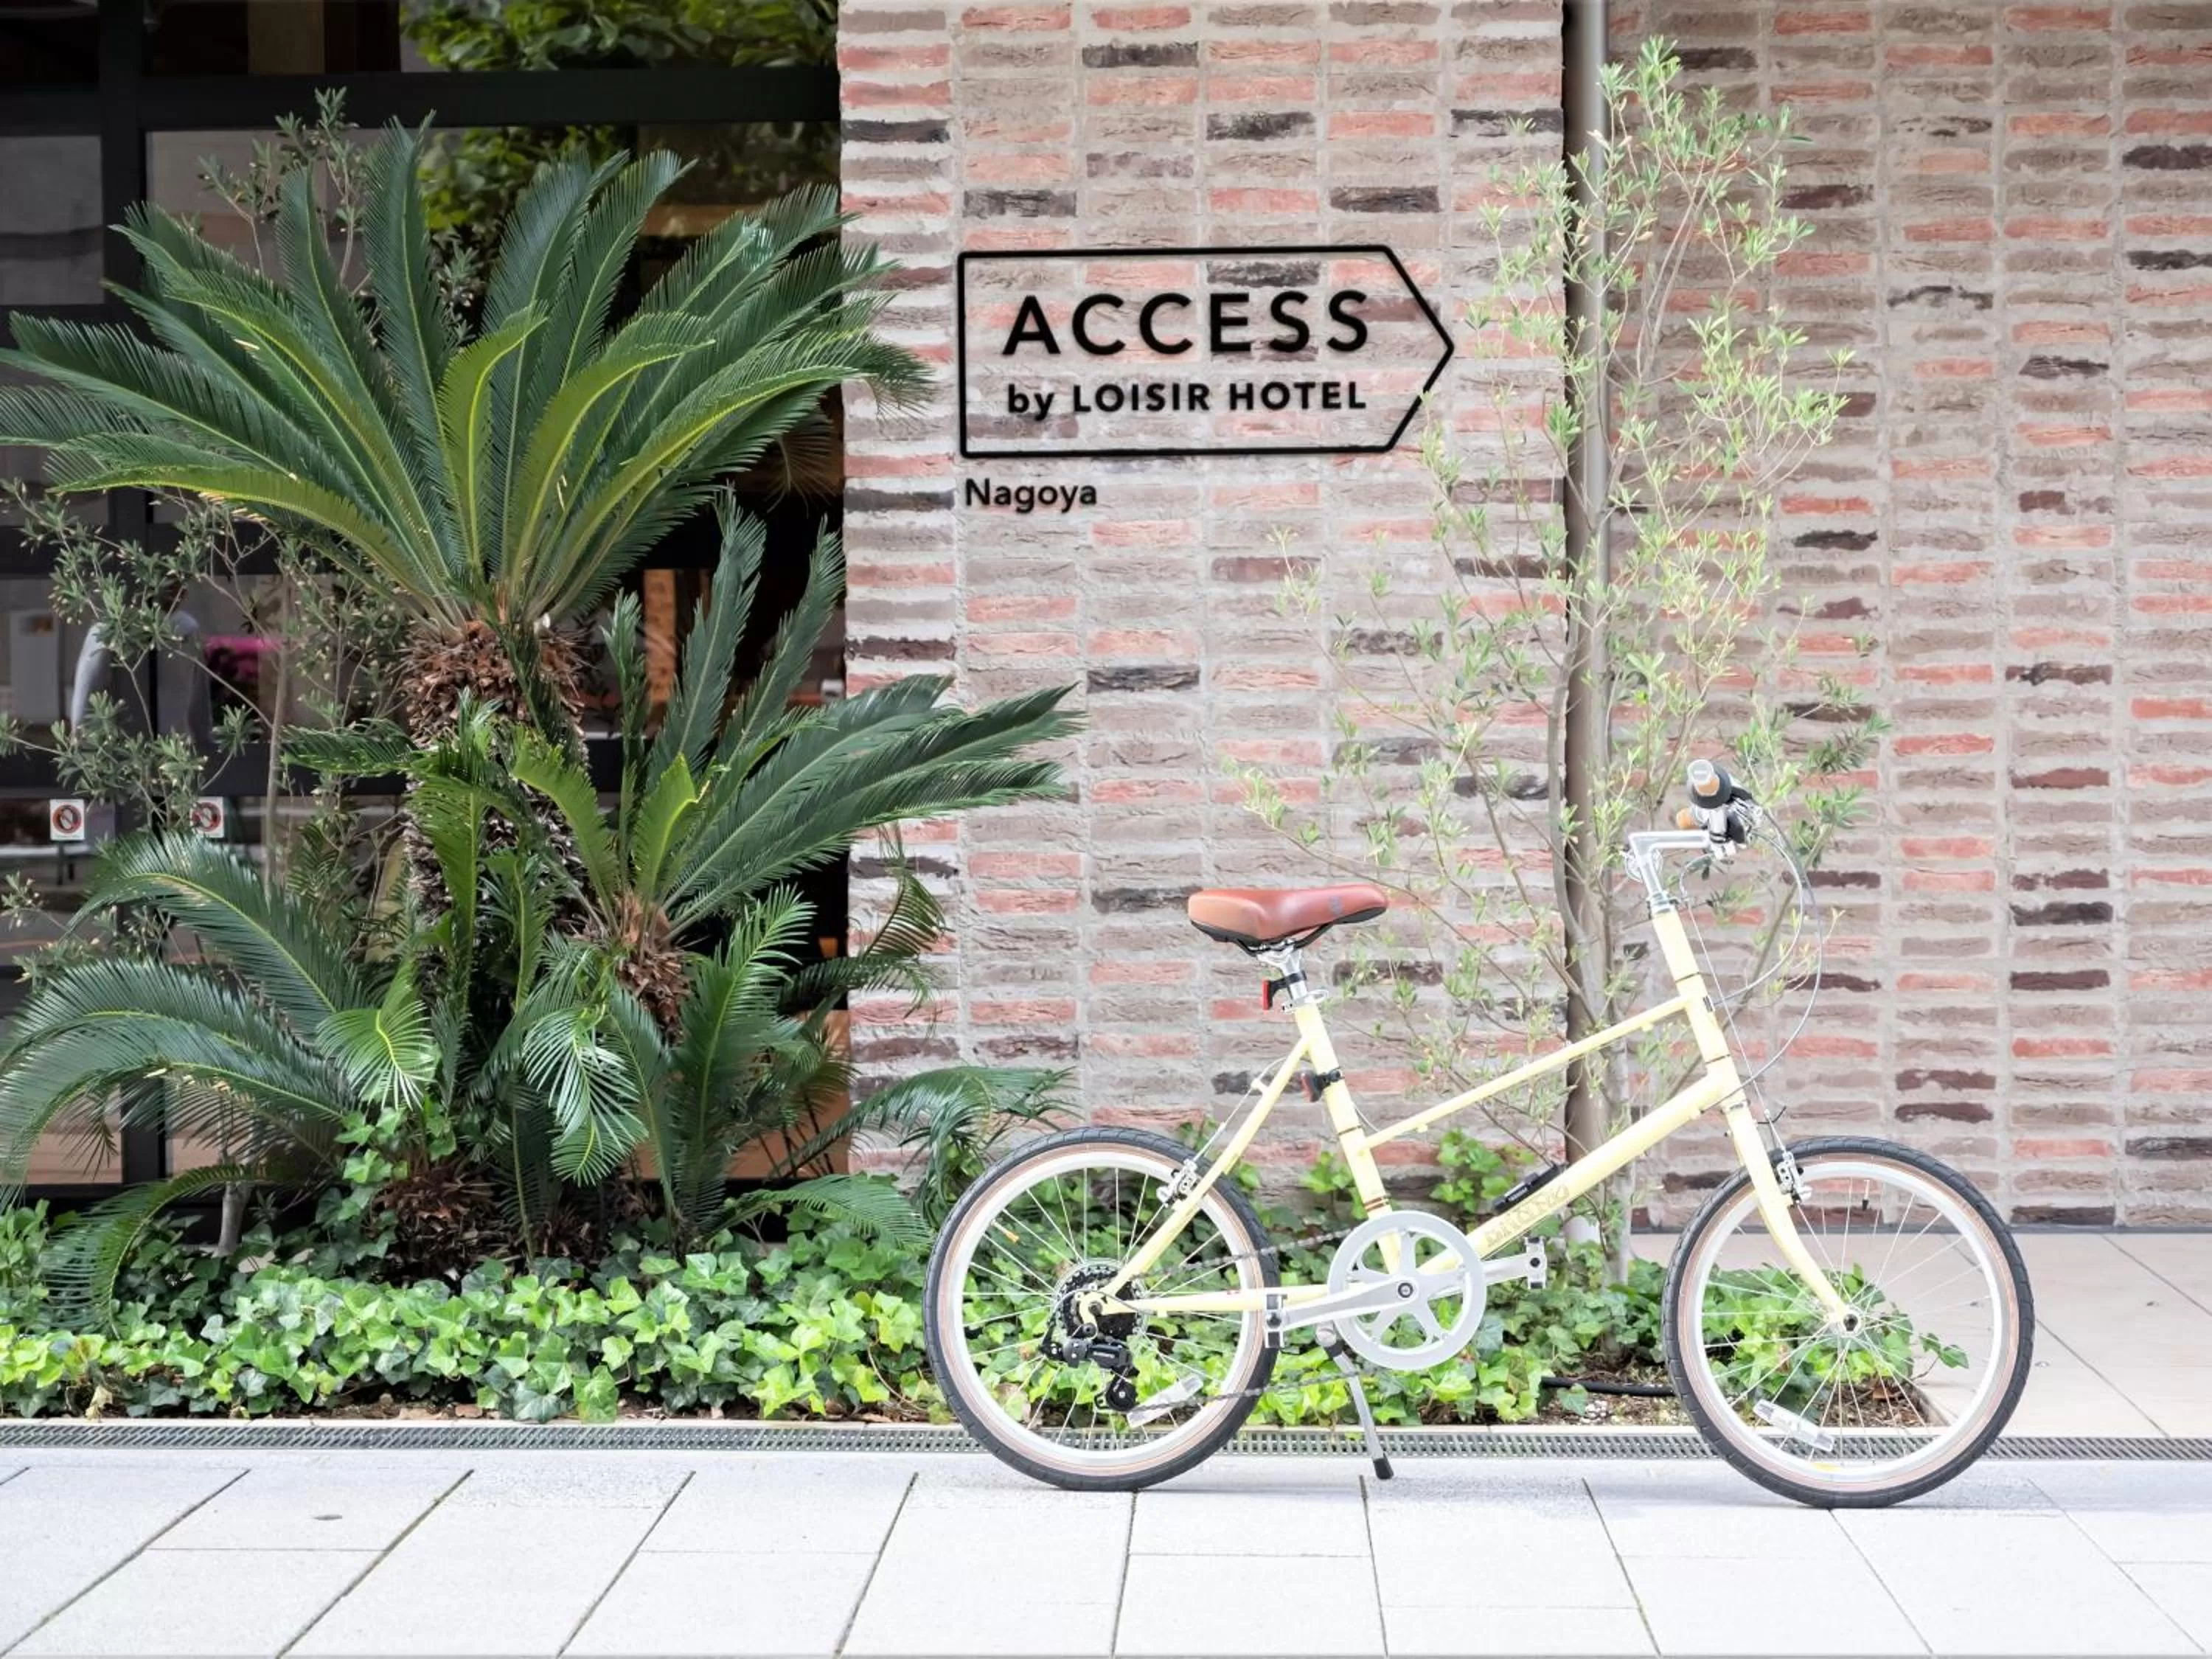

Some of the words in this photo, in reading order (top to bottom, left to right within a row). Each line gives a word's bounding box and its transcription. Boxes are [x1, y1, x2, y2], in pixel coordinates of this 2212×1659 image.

[1001, 289, 1369, 357] ACCESS
[1007, 383, 1055, 425] by
[1072, 381, 1211, 414] LOISIR
[1228, 380, 1368, 411] HOTEL
[964, 476, 1099, 515] Nagoya
